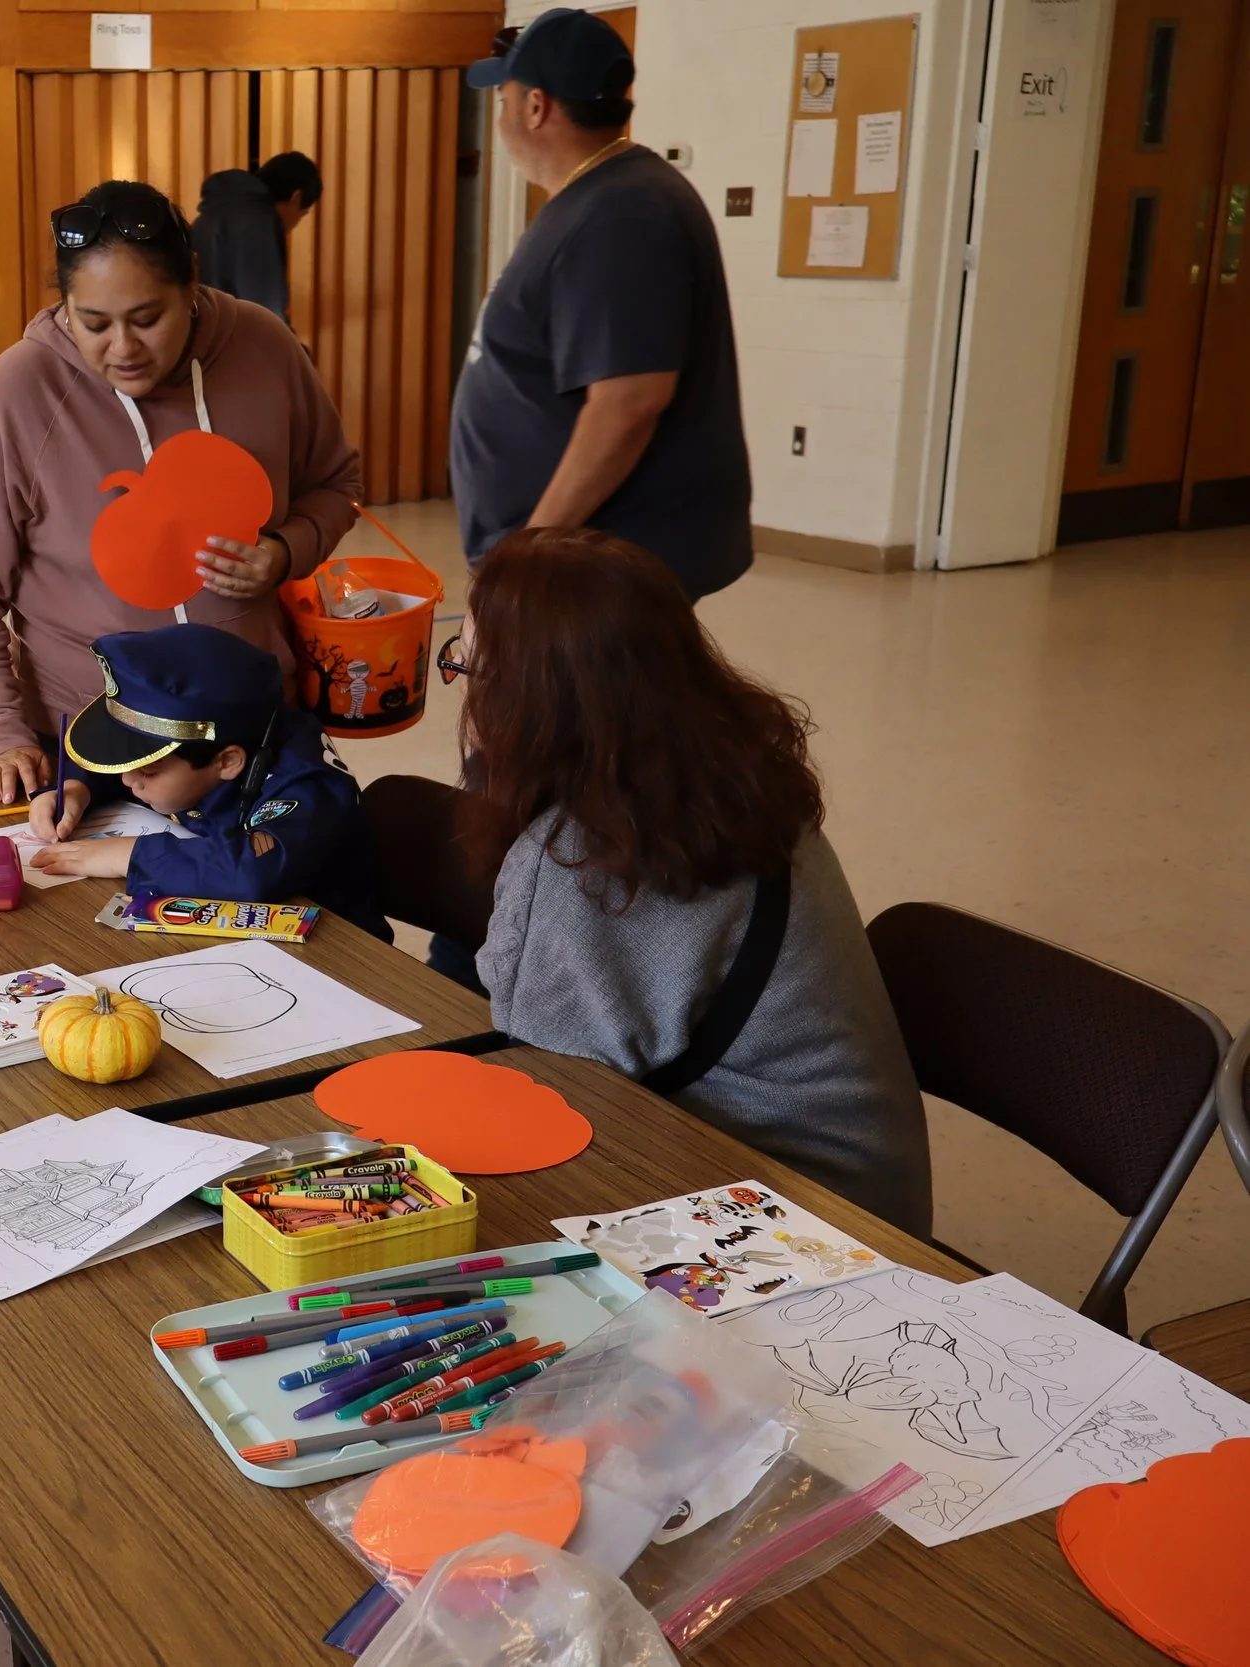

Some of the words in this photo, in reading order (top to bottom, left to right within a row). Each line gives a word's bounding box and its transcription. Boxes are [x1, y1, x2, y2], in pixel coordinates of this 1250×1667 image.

[96, 23, 118, 37] Ring
[120, 23, 142, 35] Toss
[1020, 72, 1055, 96] Exit
[231, 902, 250, 930] Colored
[250, 905, 269, 930] Pencils
[280, 906, 299, 916] 12
[347, 1163, 387, 1175] Crayola
[307, 1189, 343, 1199] Crayola
[440, 1323, 480, 1343] Crayola
[313, 1354, 357, 1374] Crayola
